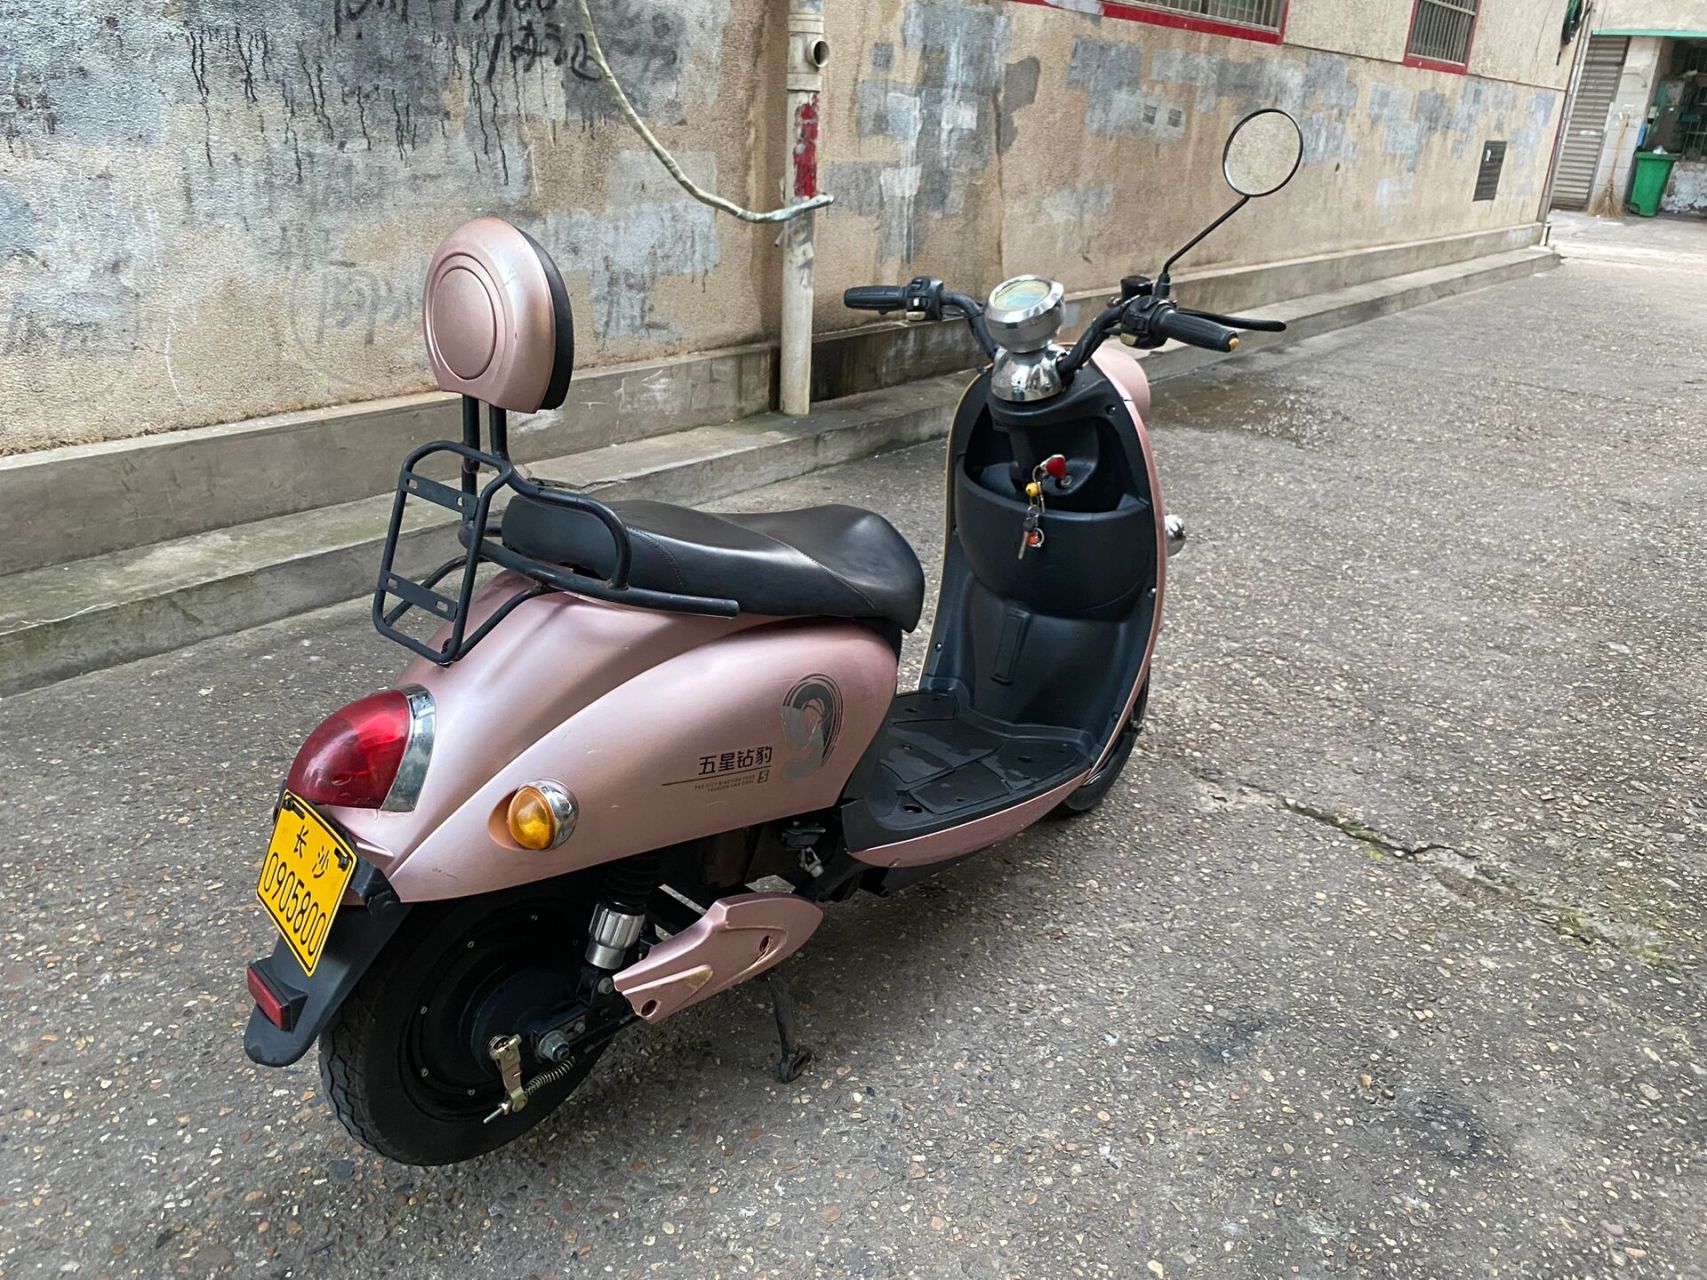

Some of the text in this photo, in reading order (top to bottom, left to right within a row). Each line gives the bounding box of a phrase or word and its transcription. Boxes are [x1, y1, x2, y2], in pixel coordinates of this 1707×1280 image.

[698, 746, 773, 776] 五星钻豹
[263, 851, 327, 957] 0905800
